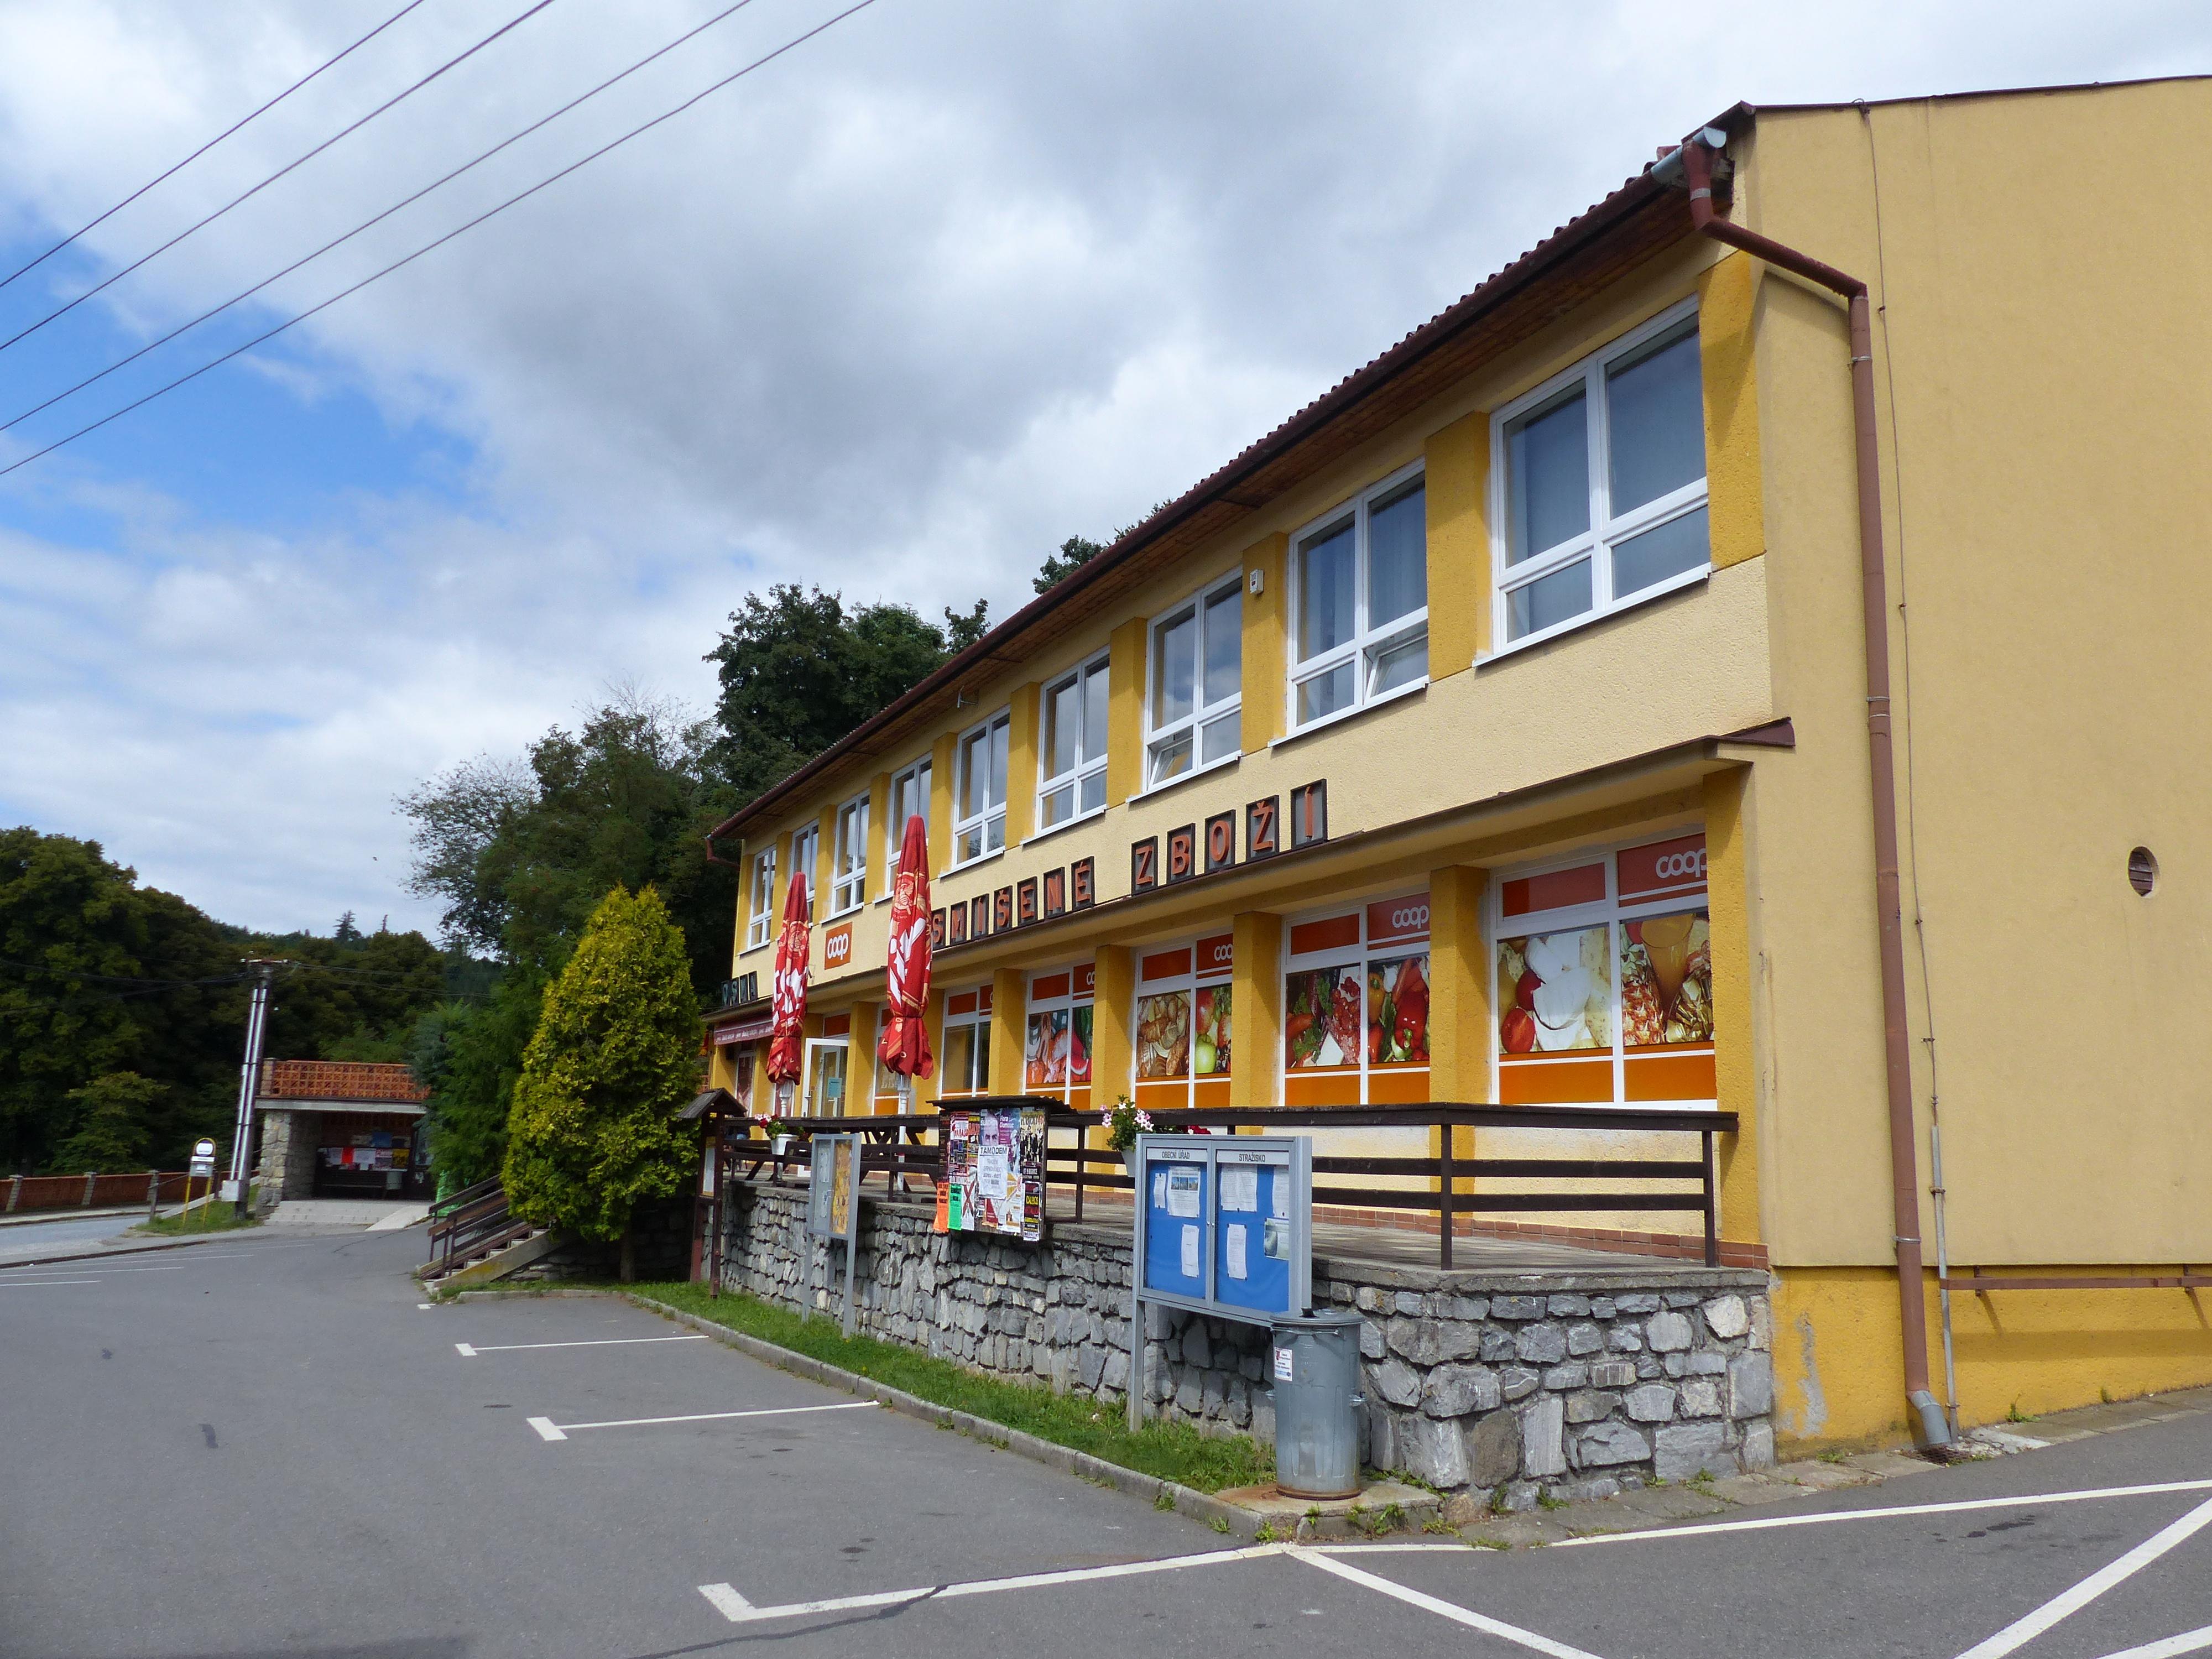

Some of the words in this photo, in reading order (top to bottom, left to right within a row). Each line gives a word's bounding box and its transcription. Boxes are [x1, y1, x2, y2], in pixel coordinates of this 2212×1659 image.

[932, 860, 1092, 943] SMÍŠENÉ
[1135, 780, 1315, 886] ZBOŽÍ
[1655, 848, 1707, 878] coop
[1392, 905, 1430, 929] coop
[827, 933, 849, 961] coop
[1214, 943, 1233, 961] coo
[1161, 1150, 1177, 1159] OBECNÍ
[1178, 1150, 1190, 1160] ÚŘAD
[1239, 1152, 1266, 1162] STRAŽISKO
